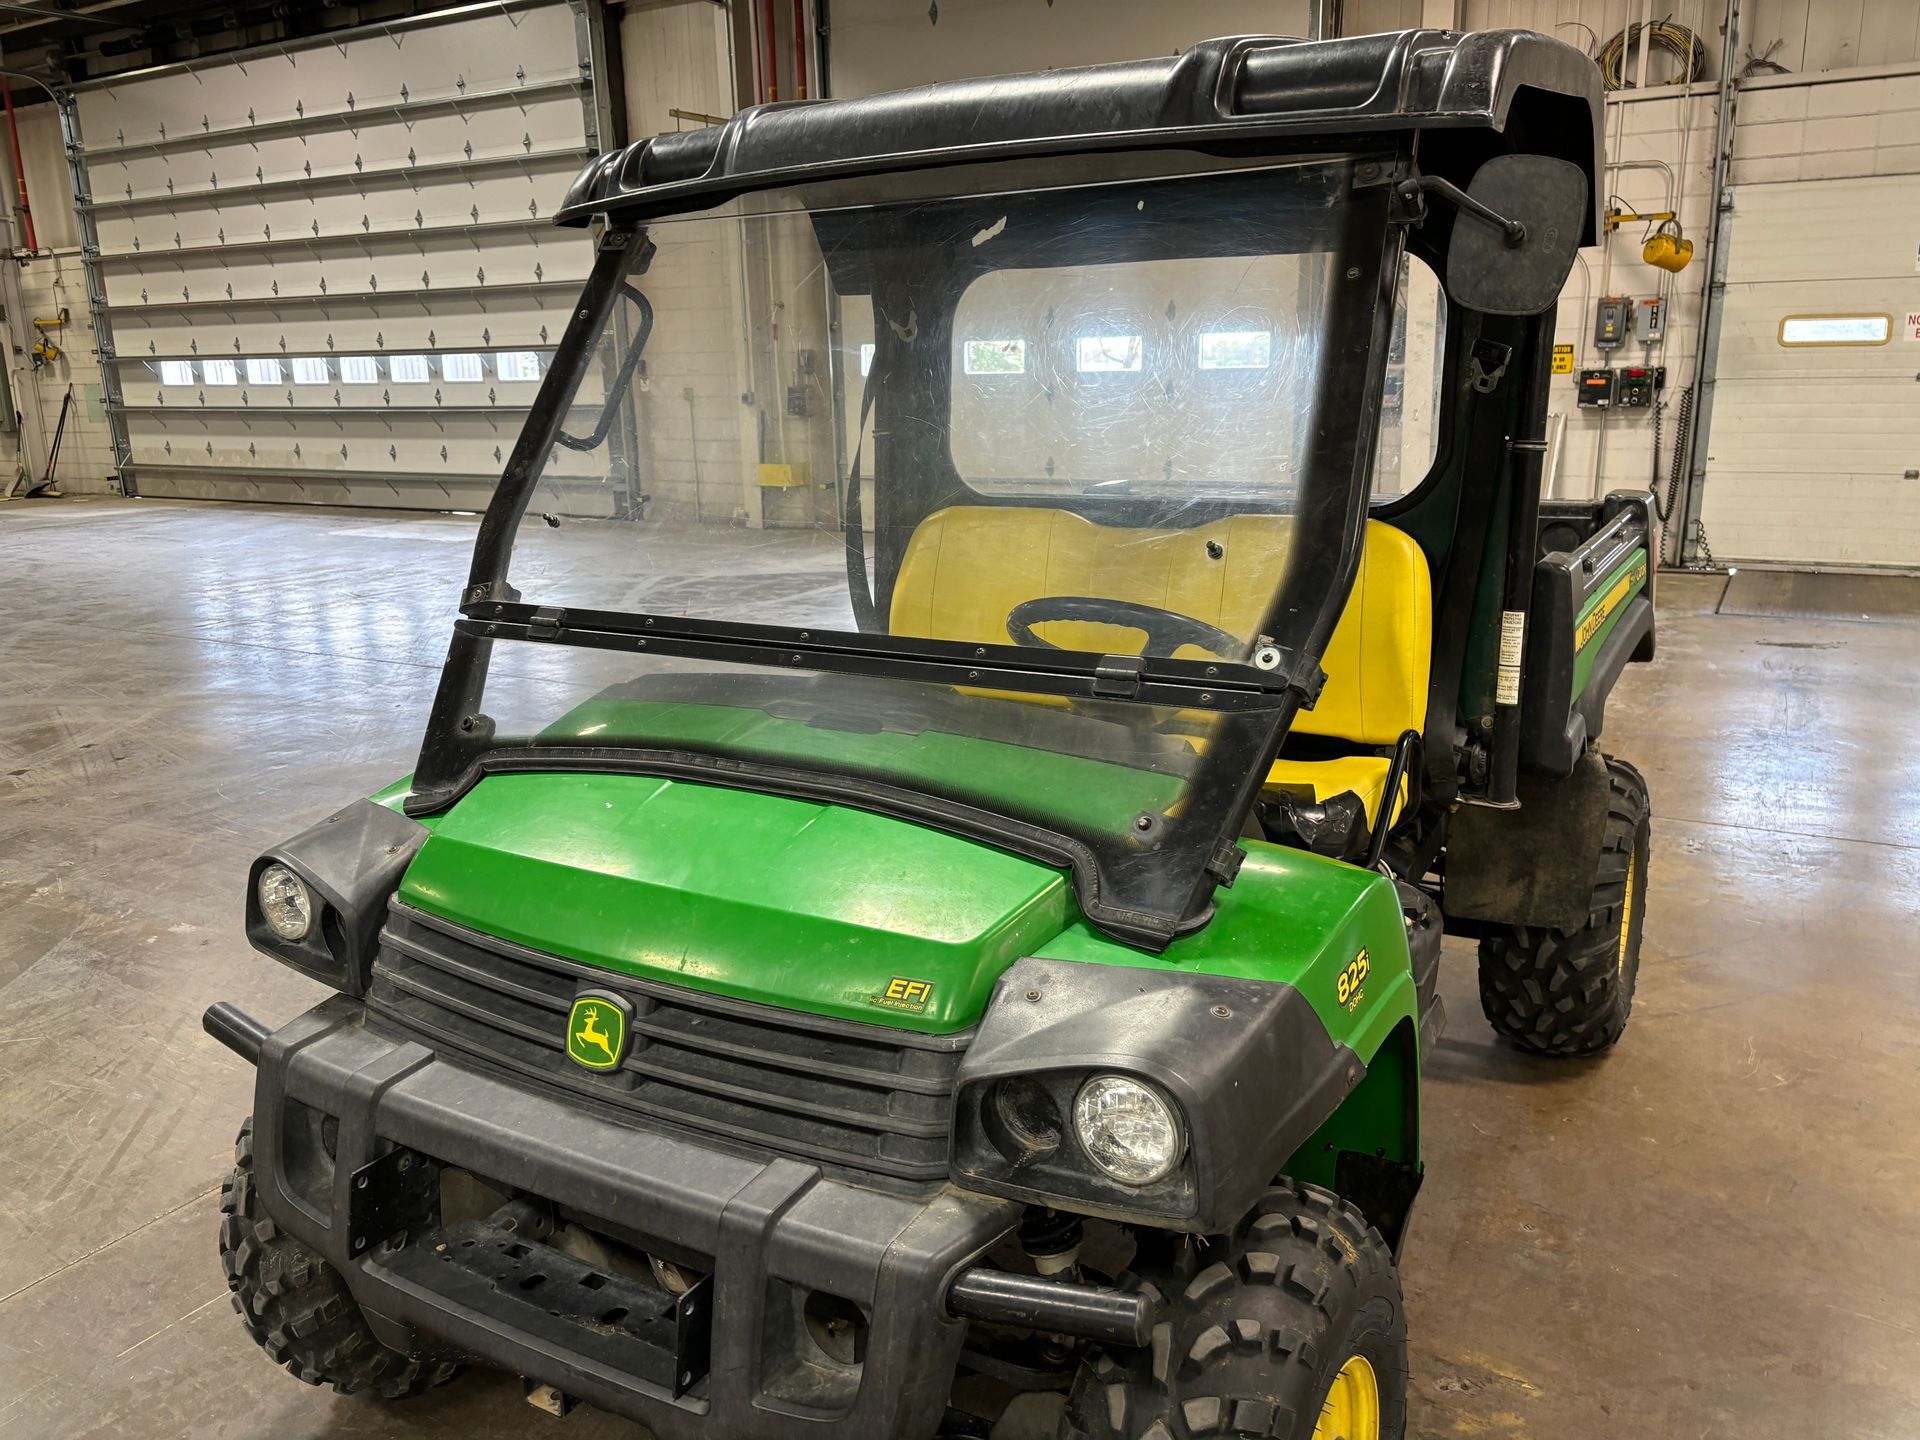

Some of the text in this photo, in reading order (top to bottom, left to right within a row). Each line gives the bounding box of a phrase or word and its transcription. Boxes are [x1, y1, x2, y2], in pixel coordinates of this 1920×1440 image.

[1337, 948, 1370, 1004] 825i
[885, 978, 932, 1003] EFI
[1348, 988, 1364, 1013] DOHC
[878, 997, 894, 1006] Fuel
[893, 1000, 923, 1011] Injection
